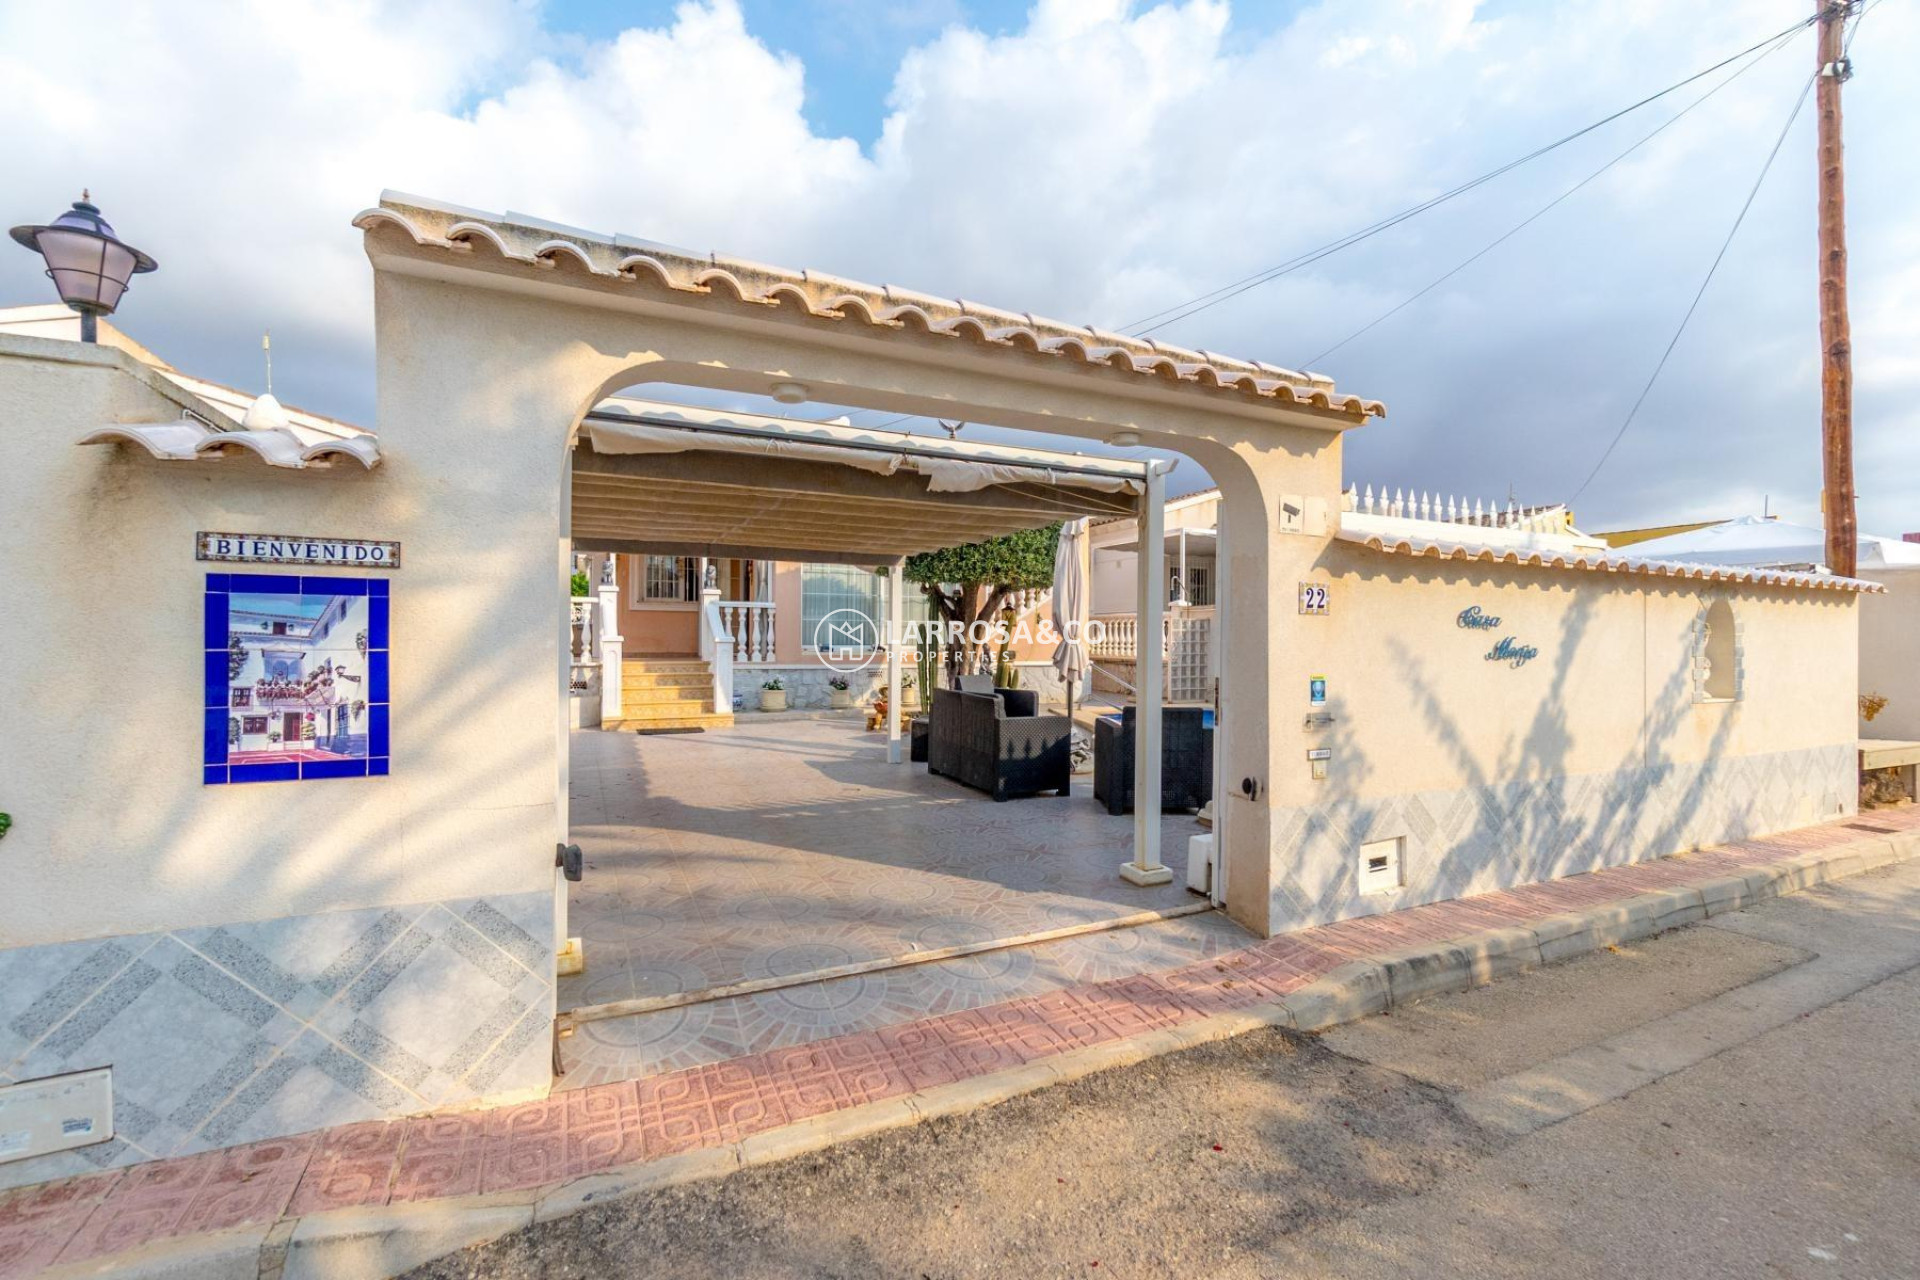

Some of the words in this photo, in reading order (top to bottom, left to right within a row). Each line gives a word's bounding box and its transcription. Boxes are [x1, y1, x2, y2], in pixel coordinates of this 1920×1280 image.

[217, 540, 384, 560] BIENVENIDO
[1306, 588, 1325, 608] 22
[1457, 606, 1501, 630] Casa
